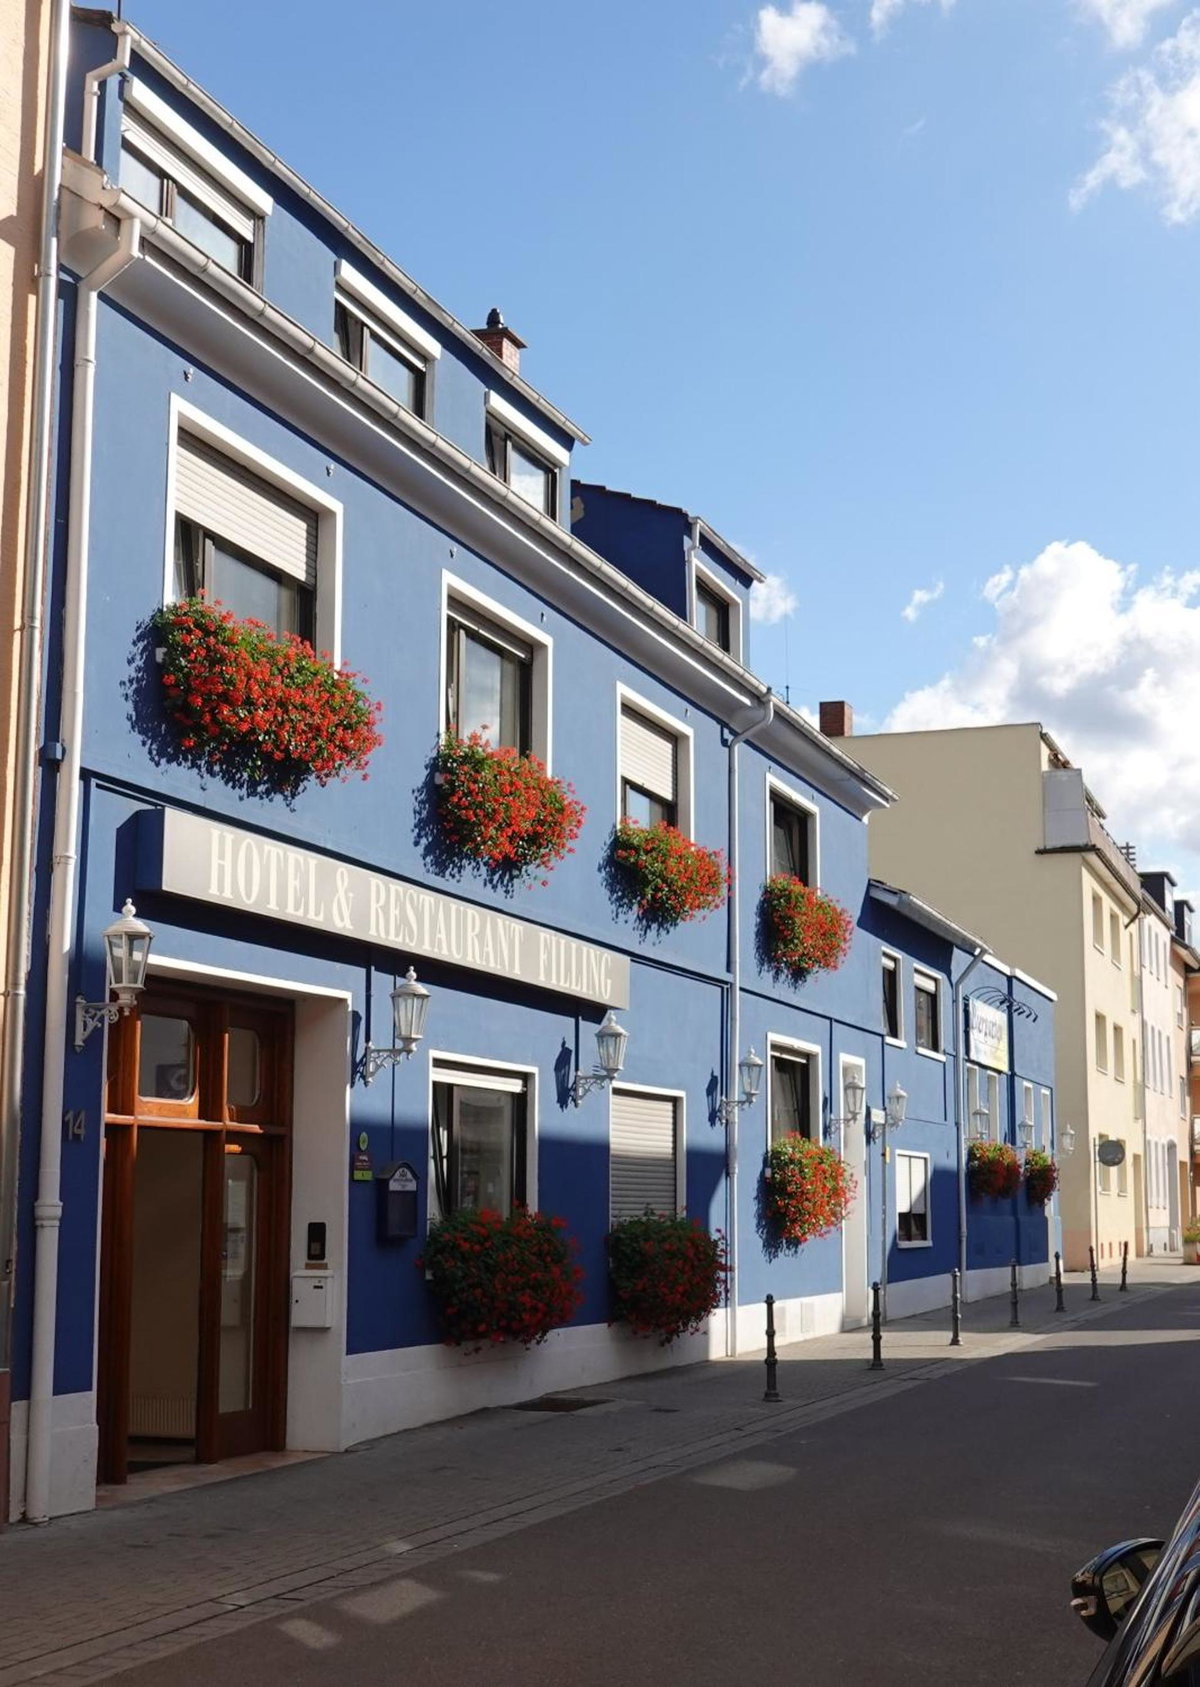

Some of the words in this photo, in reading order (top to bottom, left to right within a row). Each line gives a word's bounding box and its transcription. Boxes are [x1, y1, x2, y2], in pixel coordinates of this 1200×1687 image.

[208, 828, 325, 922] HOTEL
[332, 867, 354, 929] &
[368, 877, 523, 975] RESTAURANT
[539, 932, 612, 1000] FILLING
[65, 1110, 86, 1142] 14
